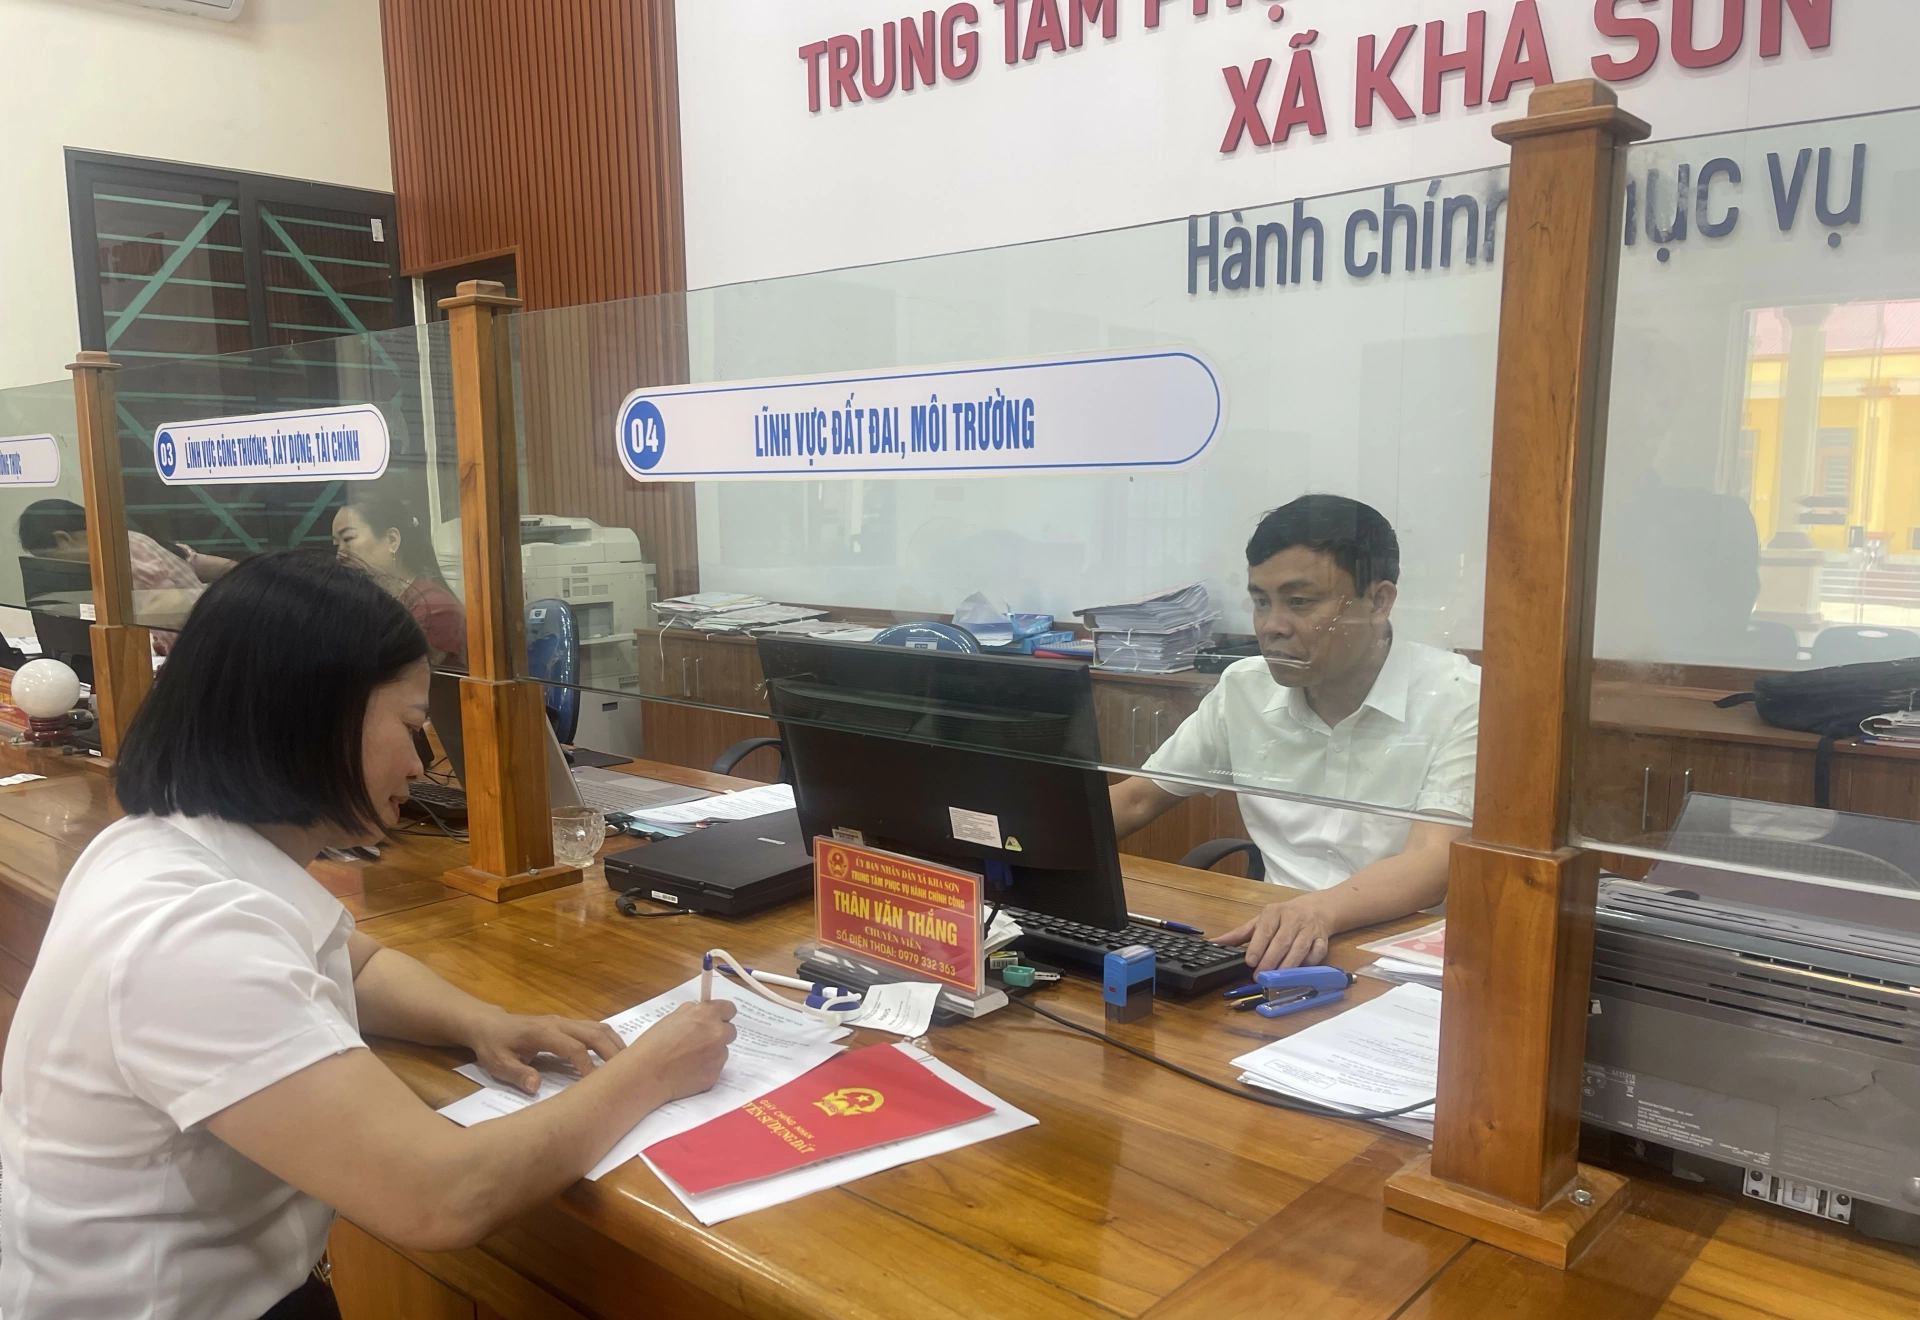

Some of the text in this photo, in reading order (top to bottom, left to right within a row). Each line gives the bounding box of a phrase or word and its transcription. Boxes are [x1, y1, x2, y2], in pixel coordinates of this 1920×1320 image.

[799, 2, 978, 112] TRUNG
[1219, 29, 1327, 153] XÃ
[1355, 0, 1553, 128] KHA
[1187, 197, 1324, 294] Hành
[1624, 157, 1741, 262] ục
[1766, 143, 1866, 248] vụ
[160, 442, 174, 466] 03
[184, 437, 202, 468] LĨNH
[201, 436, 216, 473] VỰC
[216, 433, 237, 468] CÔNG
[237, 435, 272, 468] THƯƠNG,
[270, 429, 288, 464] XÂY
[315, 426, 331, 463] TÀI
[331, 424, 360, 462] CHÍNH
[631, 387, 1035, 466] 04 LĨNH VỰC ĐẤT ĐAI, MÔI TRƯỜNG
[851, 870, 965, 910] TRUNG TÂM PHỤC VỤ HÀNH CHÍNH CÔNG
[865, 860, 879, 872] BAN
[881, 863, 902, 878] NHÂN
[902, 869, 916, 882] DÂN
[917, 873, 927, 885] XÃ
[928, 876, 943, 888] KHA
[944, 880, 960, 893] SƠN
[833, 889, 958, 946] THÂN VĂN THẮNG
[864, 925, 922, 950] CHUYÊN VIÊN
[836, 928, 956, 976] SỐ ĐIỆN THOẠI: 0979 332 363
